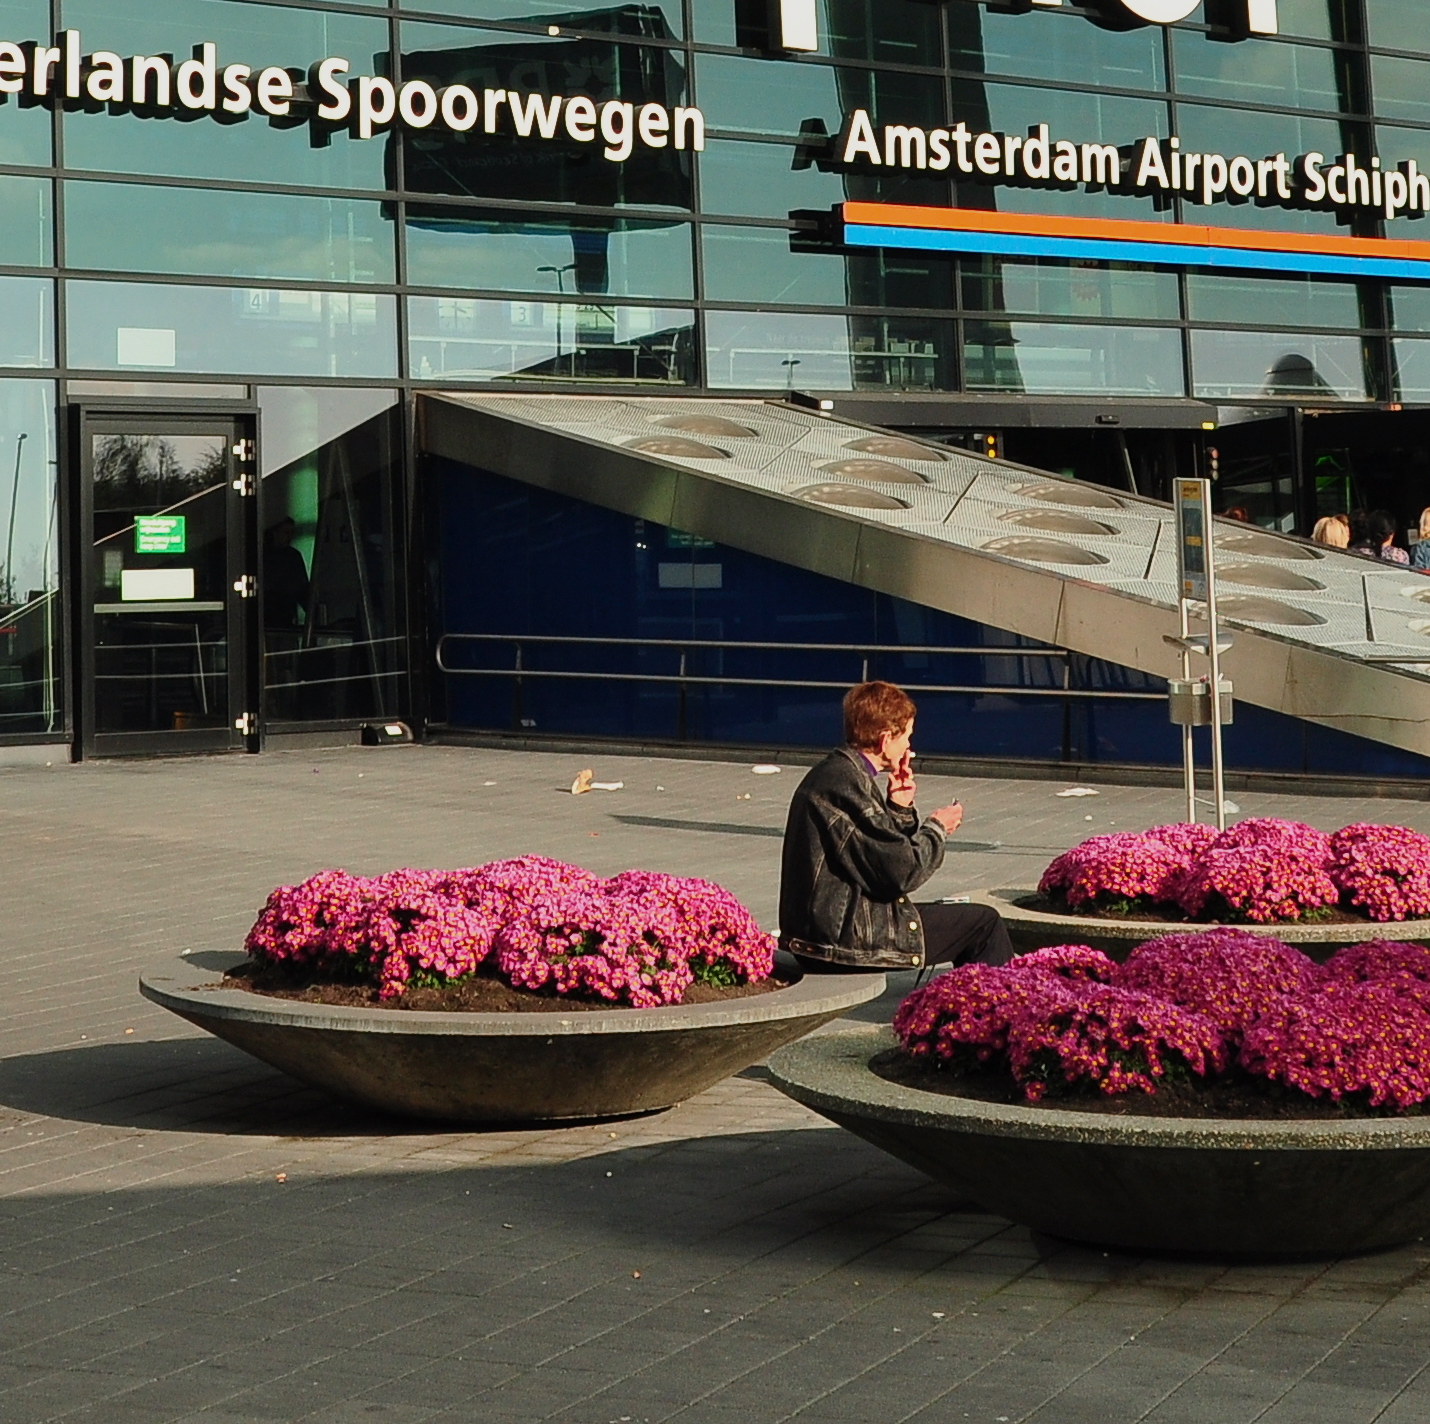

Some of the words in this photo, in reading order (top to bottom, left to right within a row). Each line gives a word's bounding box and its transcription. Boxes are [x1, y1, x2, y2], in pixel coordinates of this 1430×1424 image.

[317, 56, 705, 162] Spoorwegen
[843, 109, 1121, 185] Amsterdam
[1136, 136, 1292, 206] Airport
